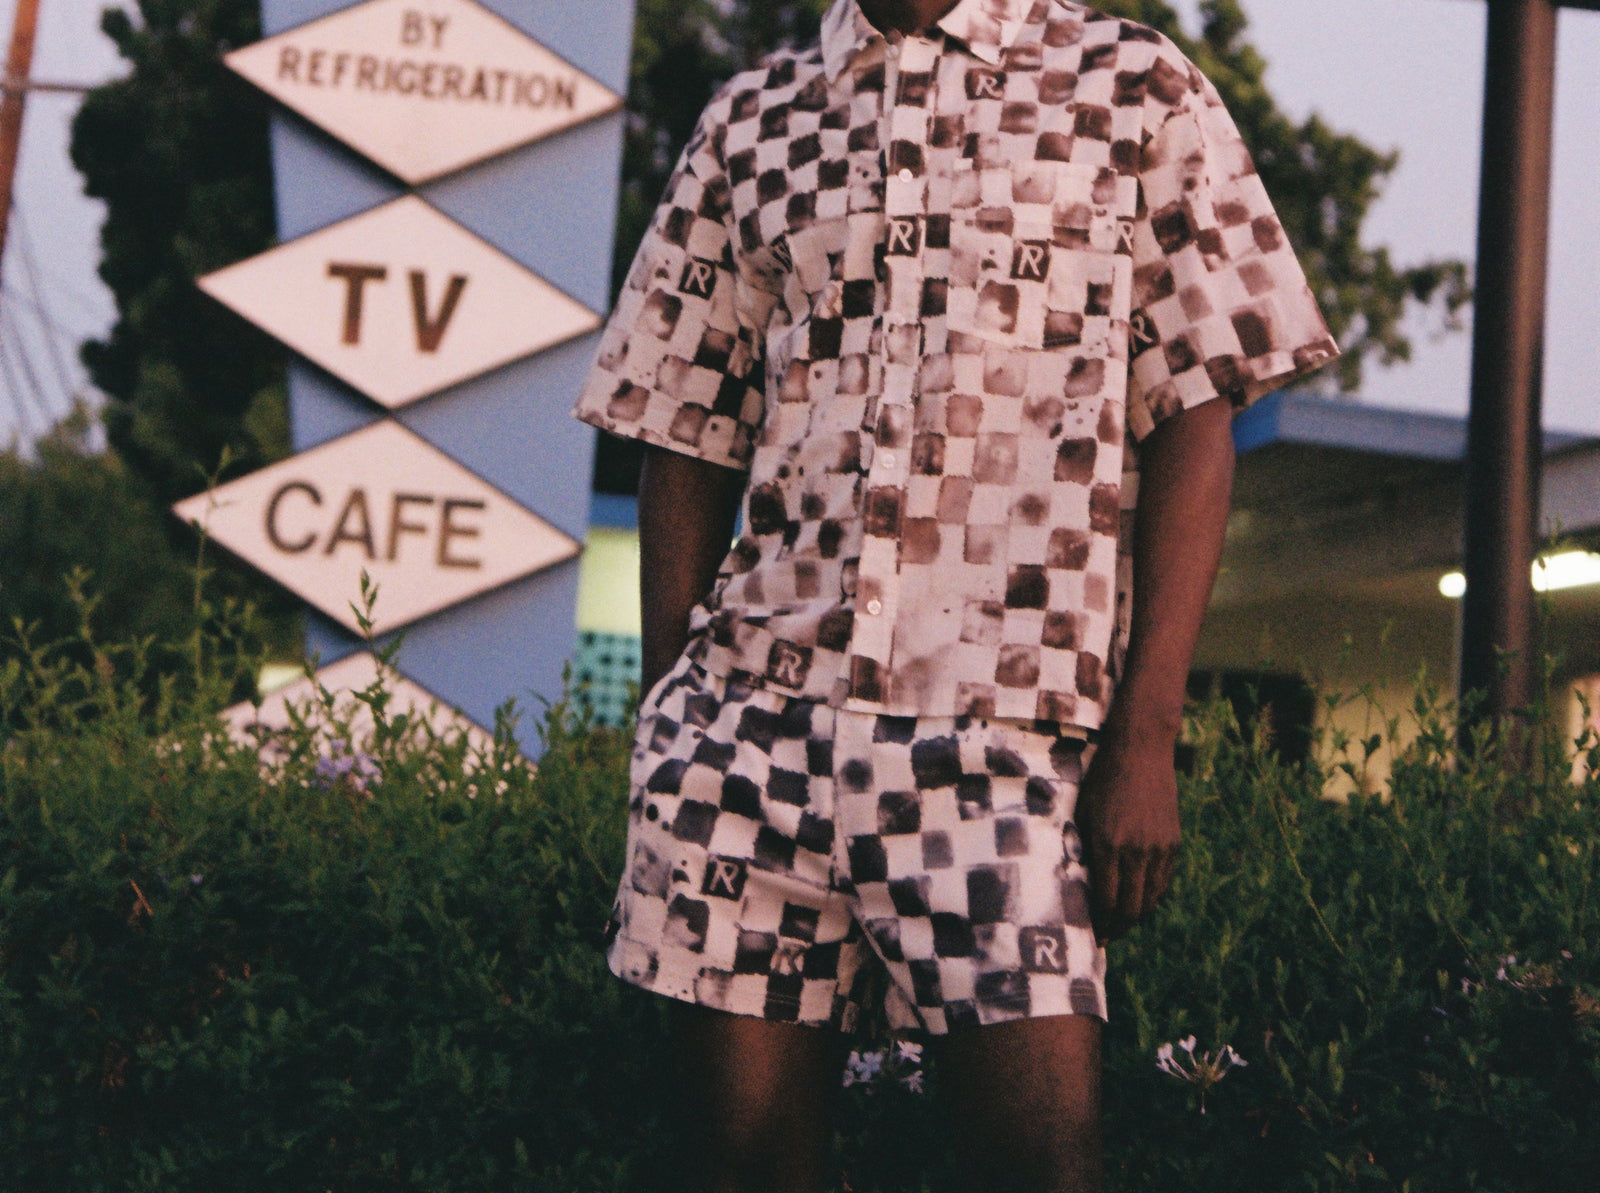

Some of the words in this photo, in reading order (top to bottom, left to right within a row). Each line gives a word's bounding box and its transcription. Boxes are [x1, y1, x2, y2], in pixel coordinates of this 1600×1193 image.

[401, 10, 449, 52] BY
[278, 45, 578, 111] REFRIGERATION
[976, 75, 1002, 97] R
[888, 219, 914, 252] R
[1014, 242, 1045, 277] R
[684, 261, 713, 294] R
[325, 261, 469, 354] TV
[263, 481, 487, 570] CAFE
[709, 861, 739, 894] R
[1034, 934, 1059, 968] R
